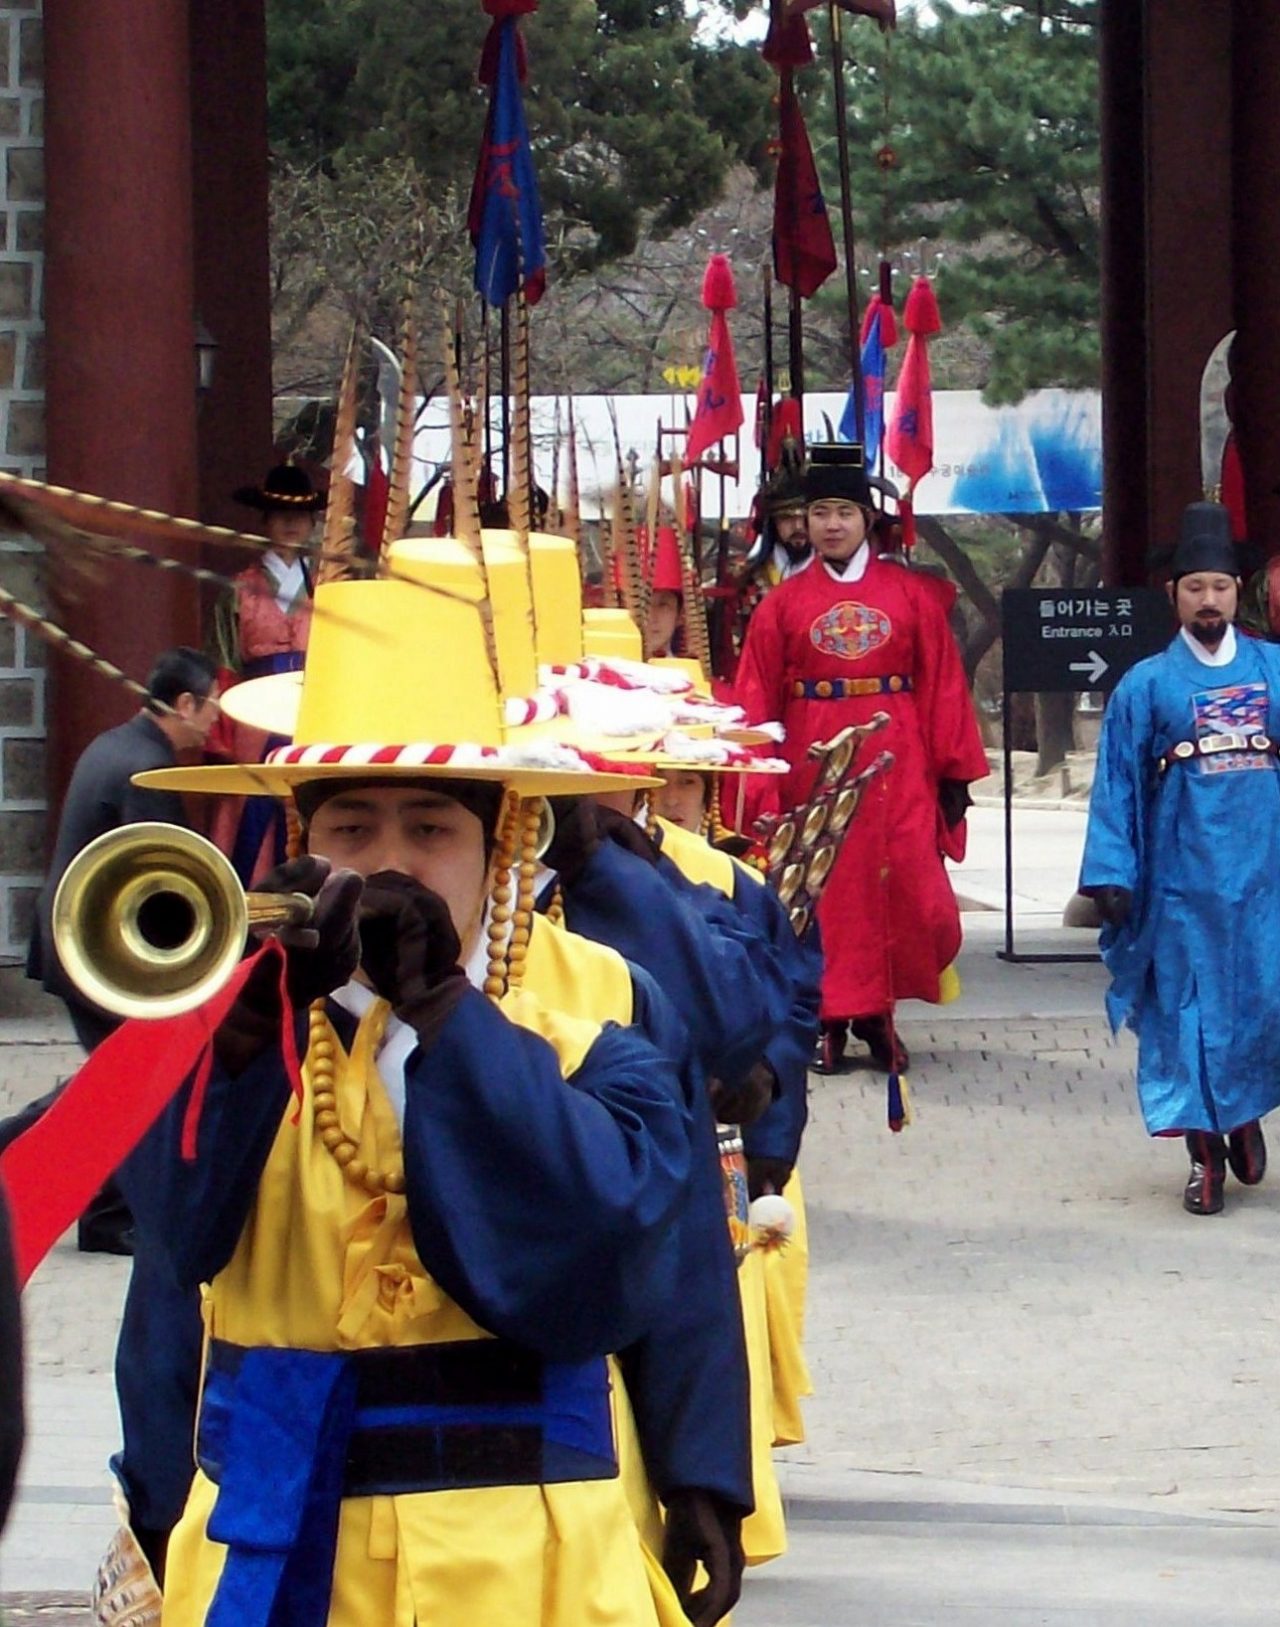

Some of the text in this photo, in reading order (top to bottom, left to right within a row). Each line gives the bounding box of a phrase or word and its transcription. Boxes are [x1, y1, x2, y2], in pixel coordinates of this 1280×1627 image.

[1039, 598, 1133, 618] 들어가는 곳
[1041, 625, 1103, 639] Entrance
